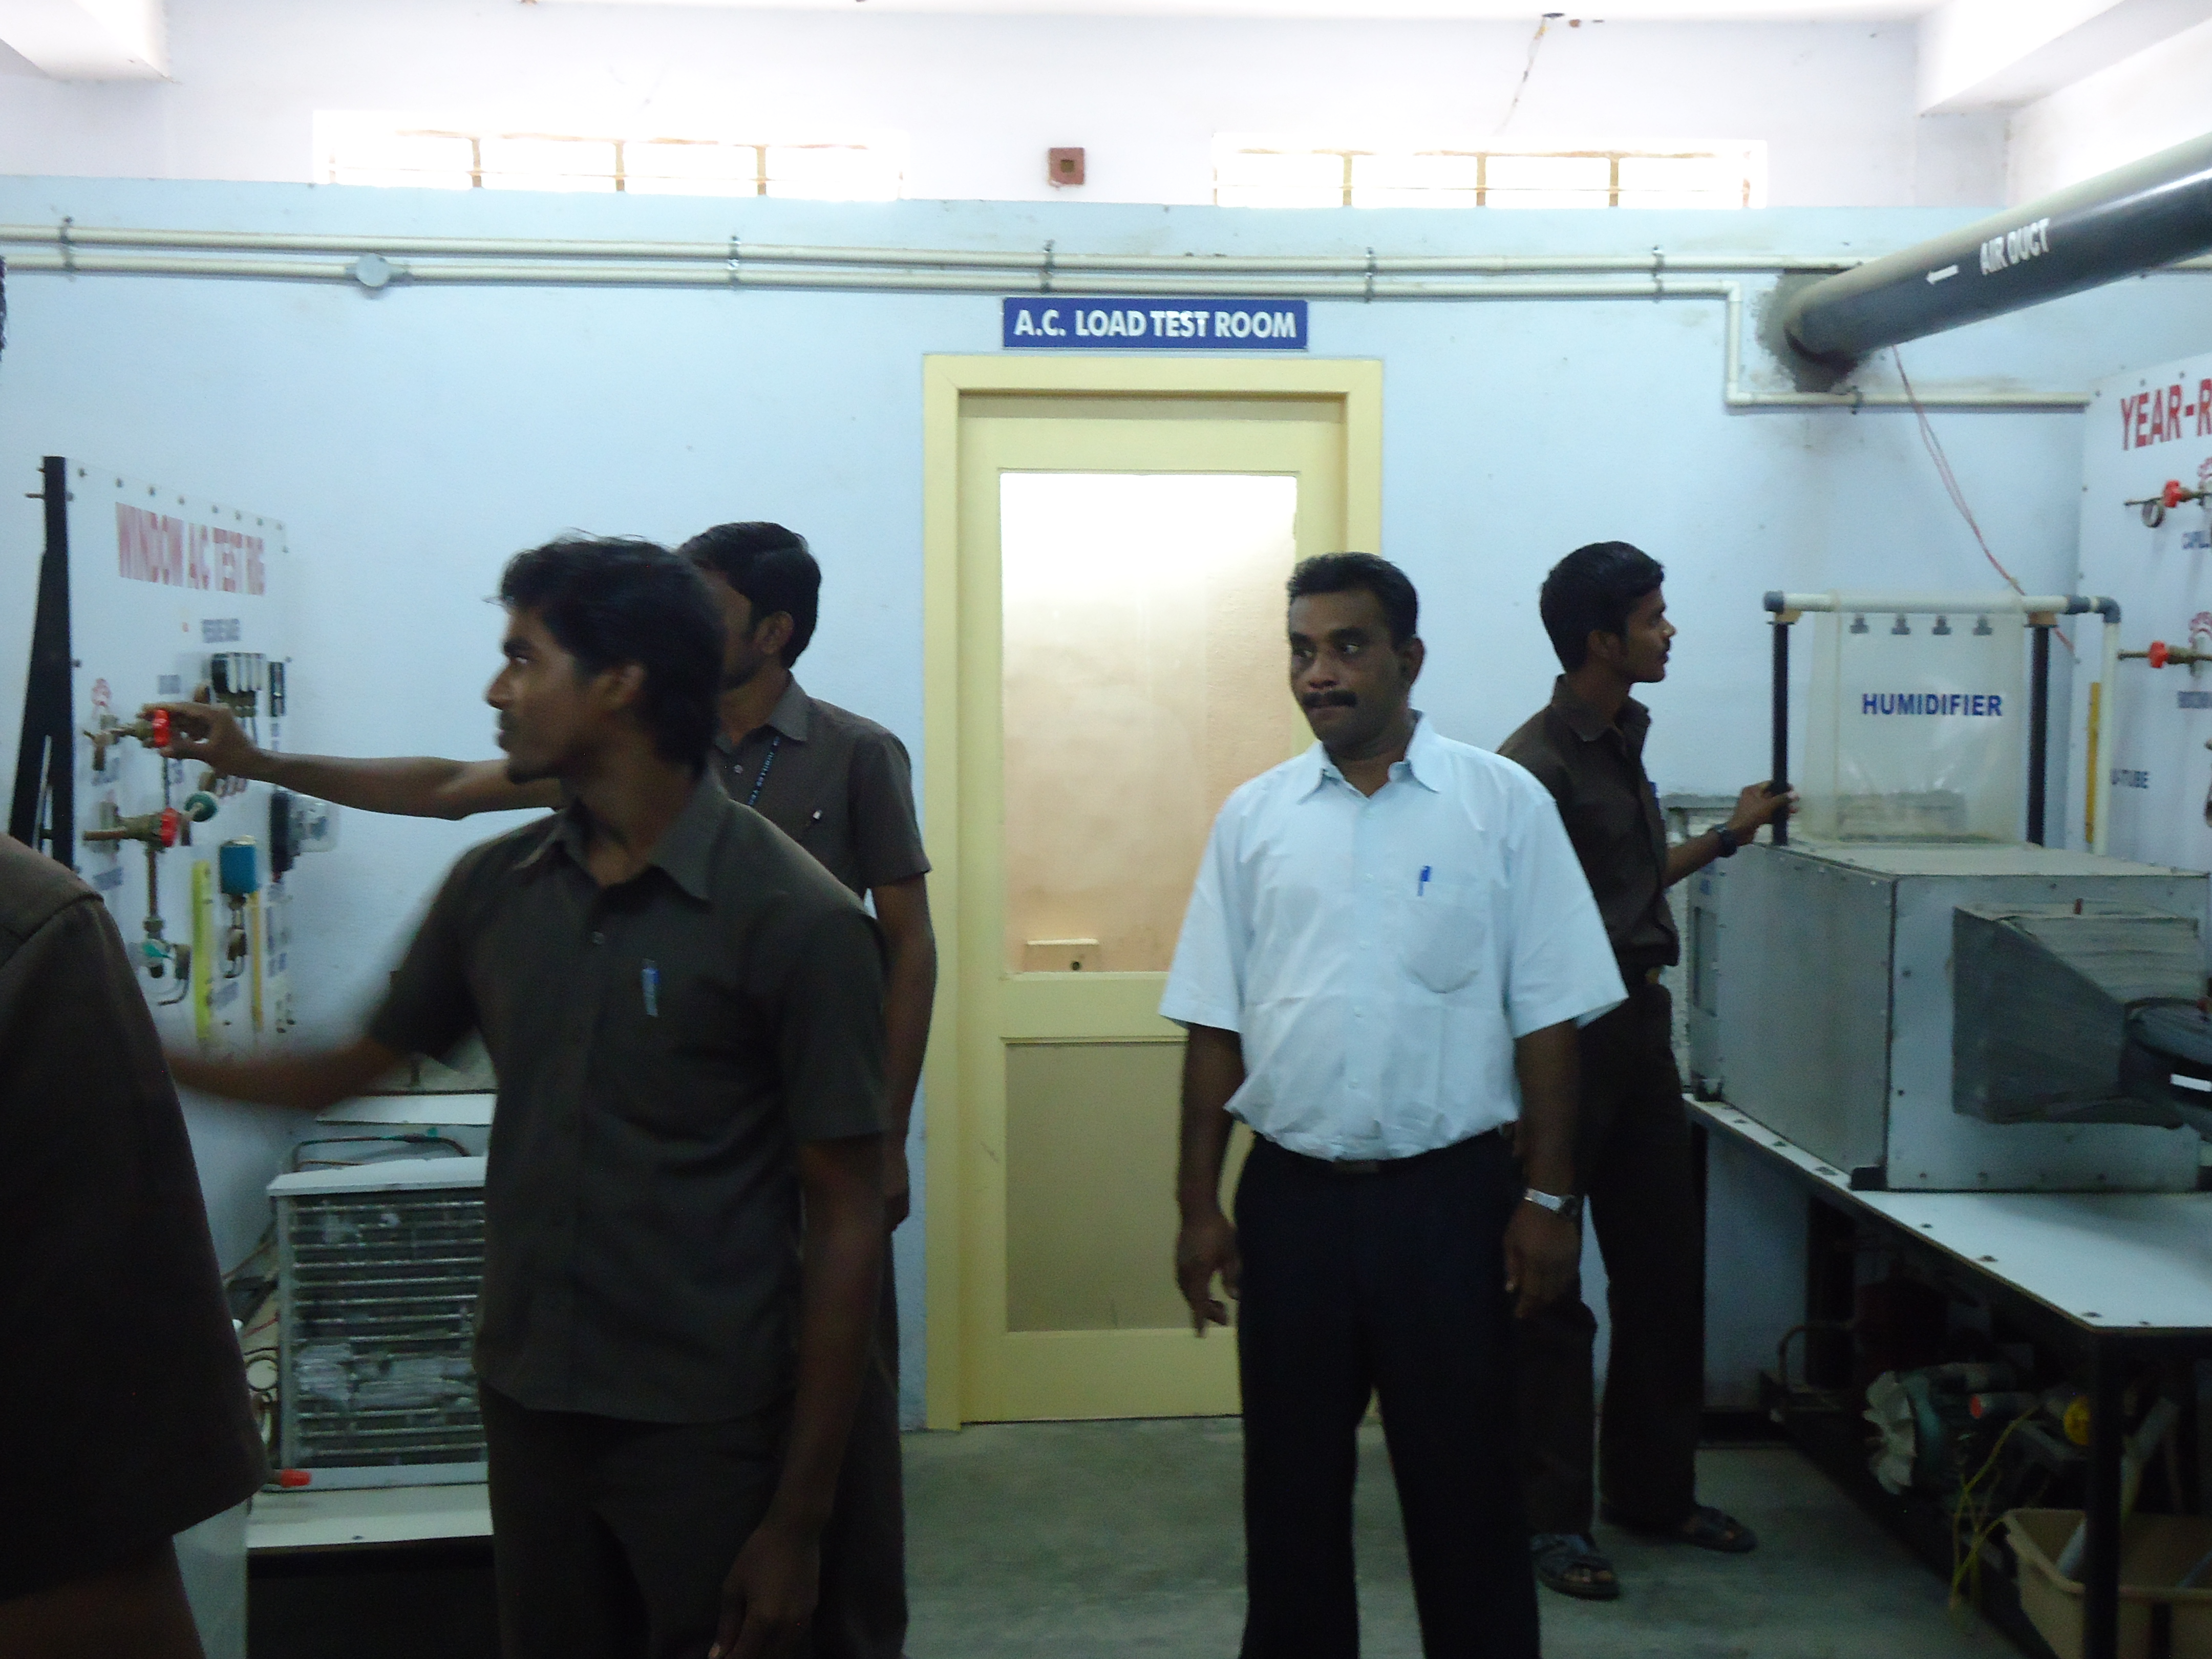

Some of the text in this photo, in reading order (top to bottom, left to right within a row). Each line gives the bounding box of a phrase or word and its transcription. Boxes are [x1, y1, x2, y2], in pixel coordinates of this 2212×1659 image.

[1980, 217, 2050, 276] AIR DUCT
[1013, 310, 1296, 338] A.C. LOAD TEST ROOM
[1862, 693, 2003, 716] HUMIDIFIER
